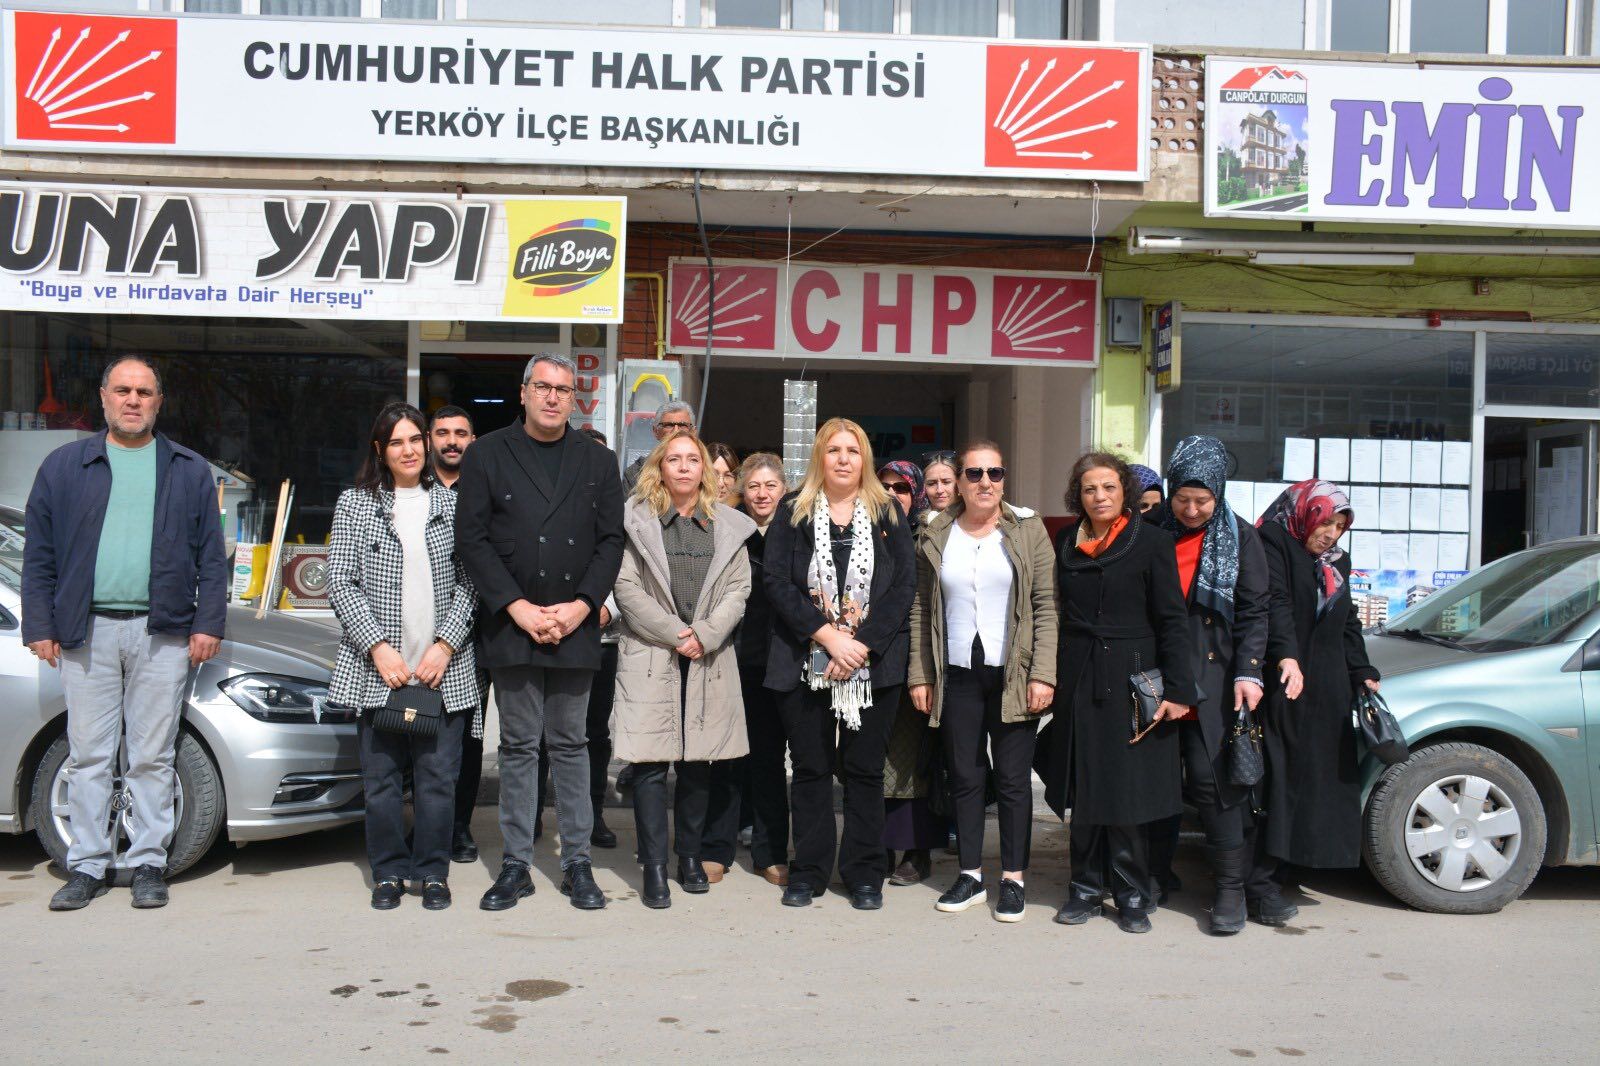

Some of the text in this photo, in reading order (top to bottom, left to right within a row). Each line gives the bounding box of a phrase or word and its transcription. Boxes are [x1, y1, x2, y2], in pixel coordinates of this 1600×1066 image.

[243, 39, 925, 98] CUMHURİYET HALK PARTİSİ
[1226, 91, 1305, 104] CANPOLAT DURGUN
[371, 107, 800, 149] YERKÖY İLÇE BAŞKANLIĞI
[1324, 77, 1583, 212] EMİN
[0, 192, 488, 283] UNA YAPI
[520, 240, 611, 273] Filli Boya
[20, 280, 374, 309] "Boya ve Hırdavata Dair Herşey"
[792, 269, 977, 355] CHP
